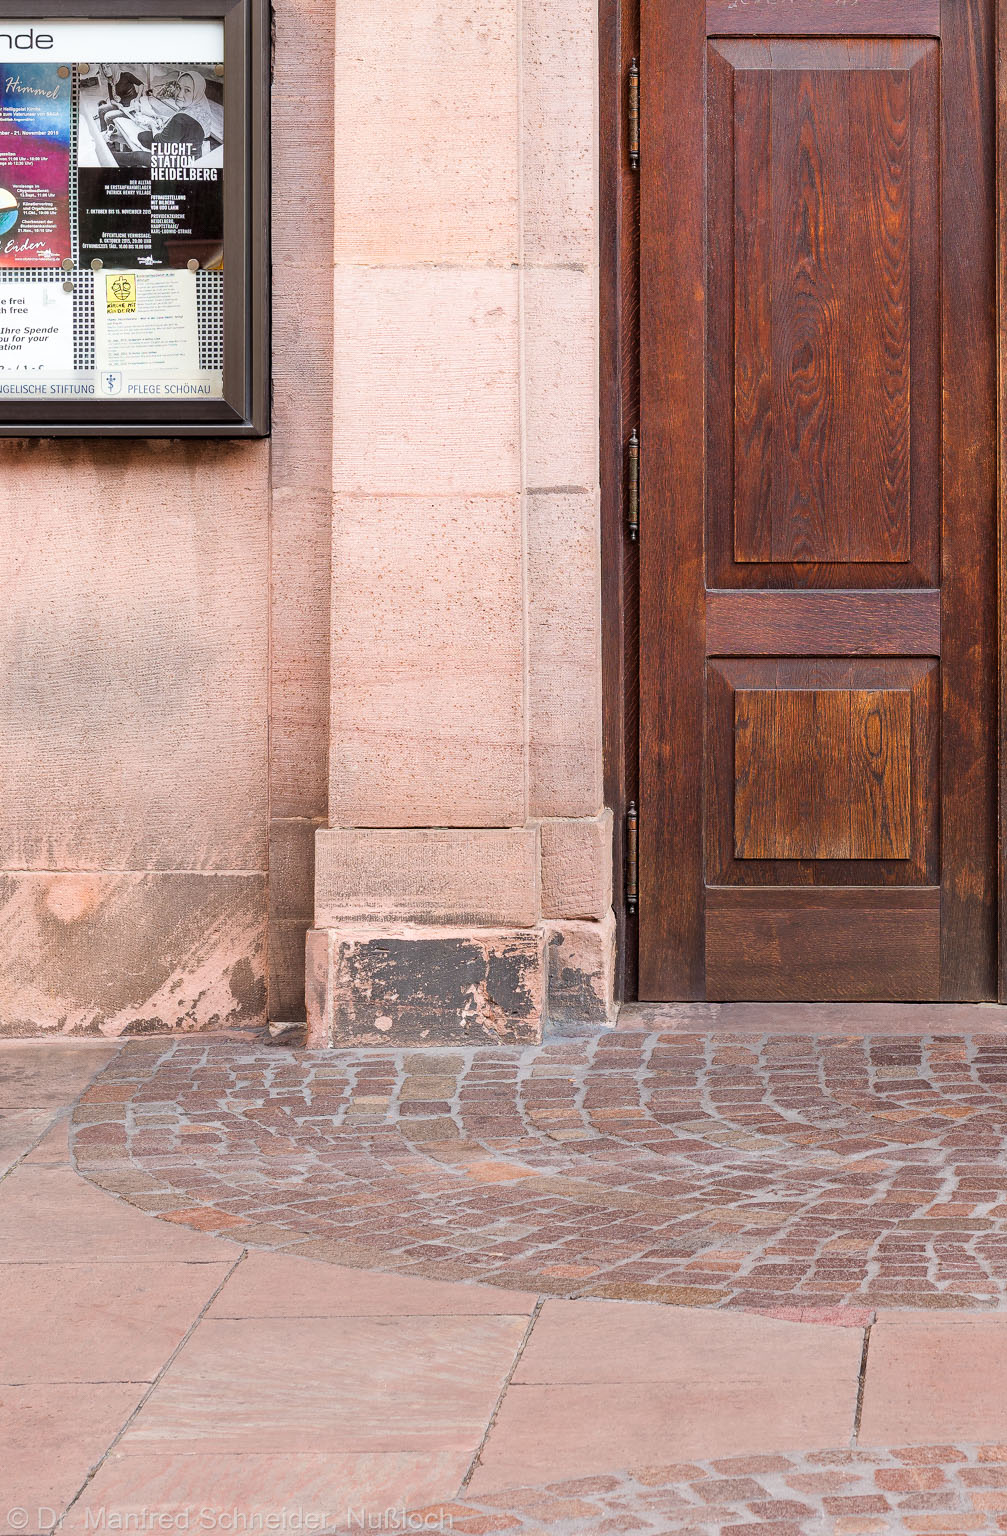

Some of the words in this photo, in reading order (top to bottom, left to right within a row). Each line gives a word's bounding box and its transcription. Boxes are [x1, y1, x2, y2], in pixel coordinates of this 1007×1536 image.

[5, 76, 60, 99] Himmel
[151, 143, 197, 155] FLUCHT-
[151, 155, 195, 167] STATION
[151, 168, 217, 180] HEIDELBERG
[9, 297, 25, 305] frei
[24, 326, 59, 335] Spende
[50, 385, 95, 394] STIFTUNG
[128, 385, 161, 394] PFLEGE
[164, 382, 211, 394] SCHÖNAU
